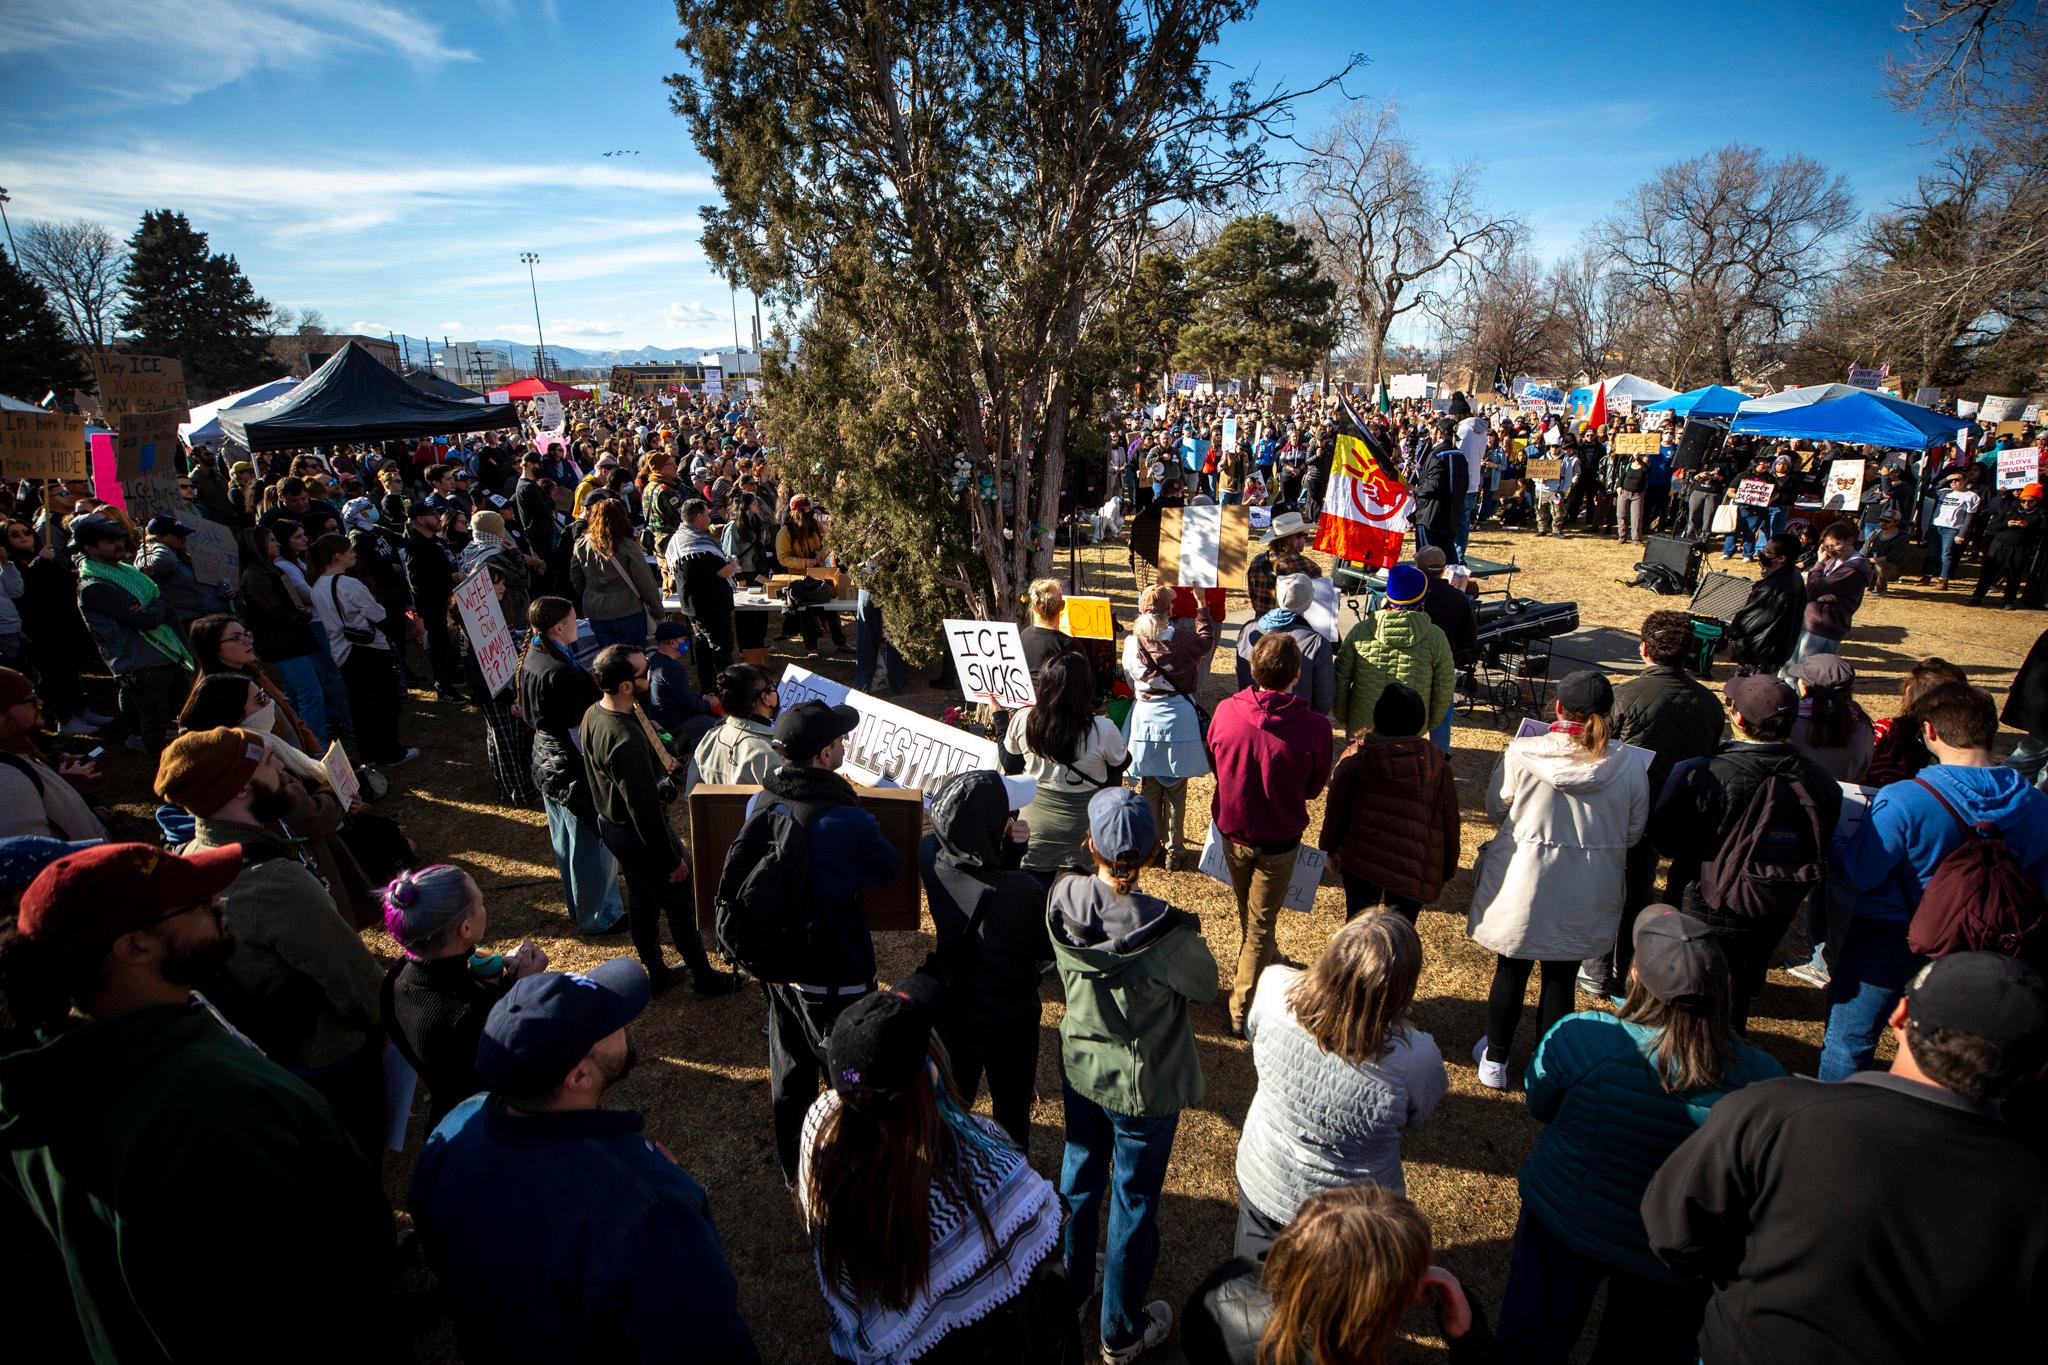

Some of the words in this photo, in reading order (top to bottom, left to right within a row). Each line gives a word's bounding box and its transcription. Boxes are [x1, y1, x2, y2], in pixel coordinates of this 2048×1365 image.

[101, 357, 125, 378] Hey
[35, 412, 60, 431] here
[51, 450, 82, 474] HIDE
[474, 600, 490, 622] IS
[481, 616, 498, 639] OUR
[954, 628, 1016, 661] ICE
[967, 663, 1030, 704] SUCKS
